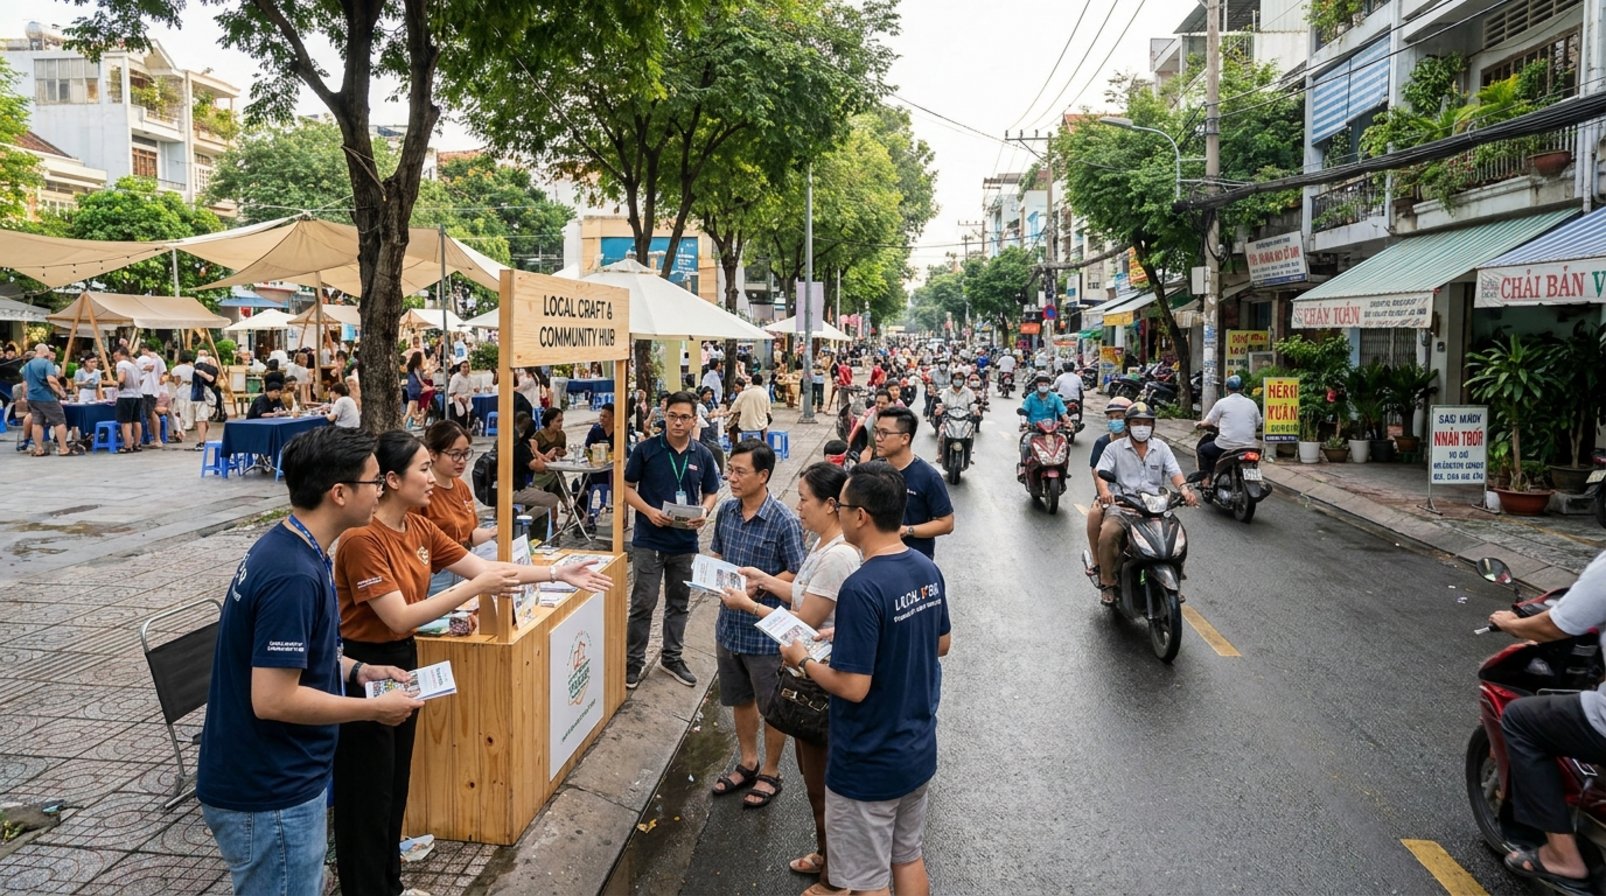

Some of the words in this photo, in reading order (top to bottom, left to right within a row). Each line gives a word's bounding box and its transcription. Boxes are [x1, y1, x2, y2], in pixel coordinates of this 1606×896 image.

[543, 294, 576, 317] LOCAL
[578, 299, 605, 319] CRAFT
[606, 302, 613, 320] &
[540, 326, 597, 347] COMMUNITY
[599, 328, 615, 346] HUB
